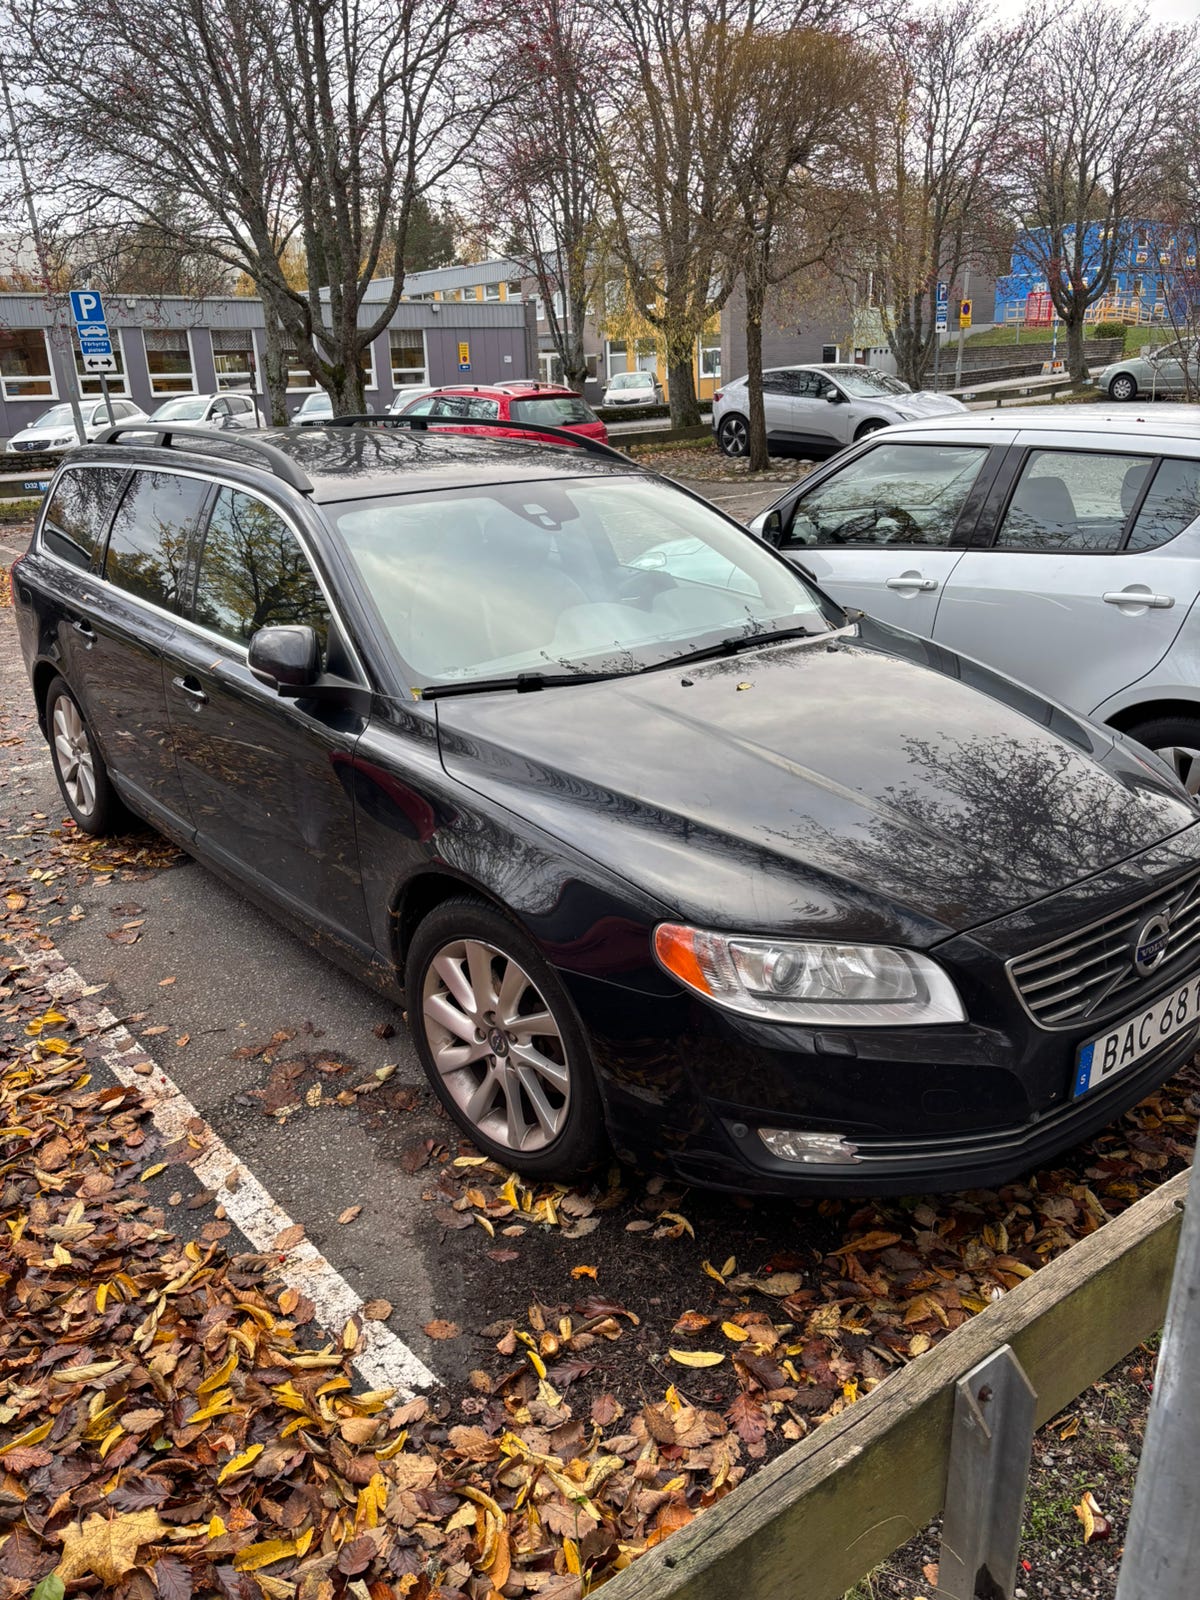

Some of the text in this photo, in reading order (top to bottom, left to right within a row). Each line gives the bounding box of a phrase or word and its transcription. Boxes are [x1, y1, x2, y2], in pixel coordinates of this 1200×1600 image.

[78, 294, 97, 319] P
[1140, 936, 1169, 957] VOLVO
[1101, 1012, 1153, 1075] BAC
[1079, 1073, 1086, 1085] S
